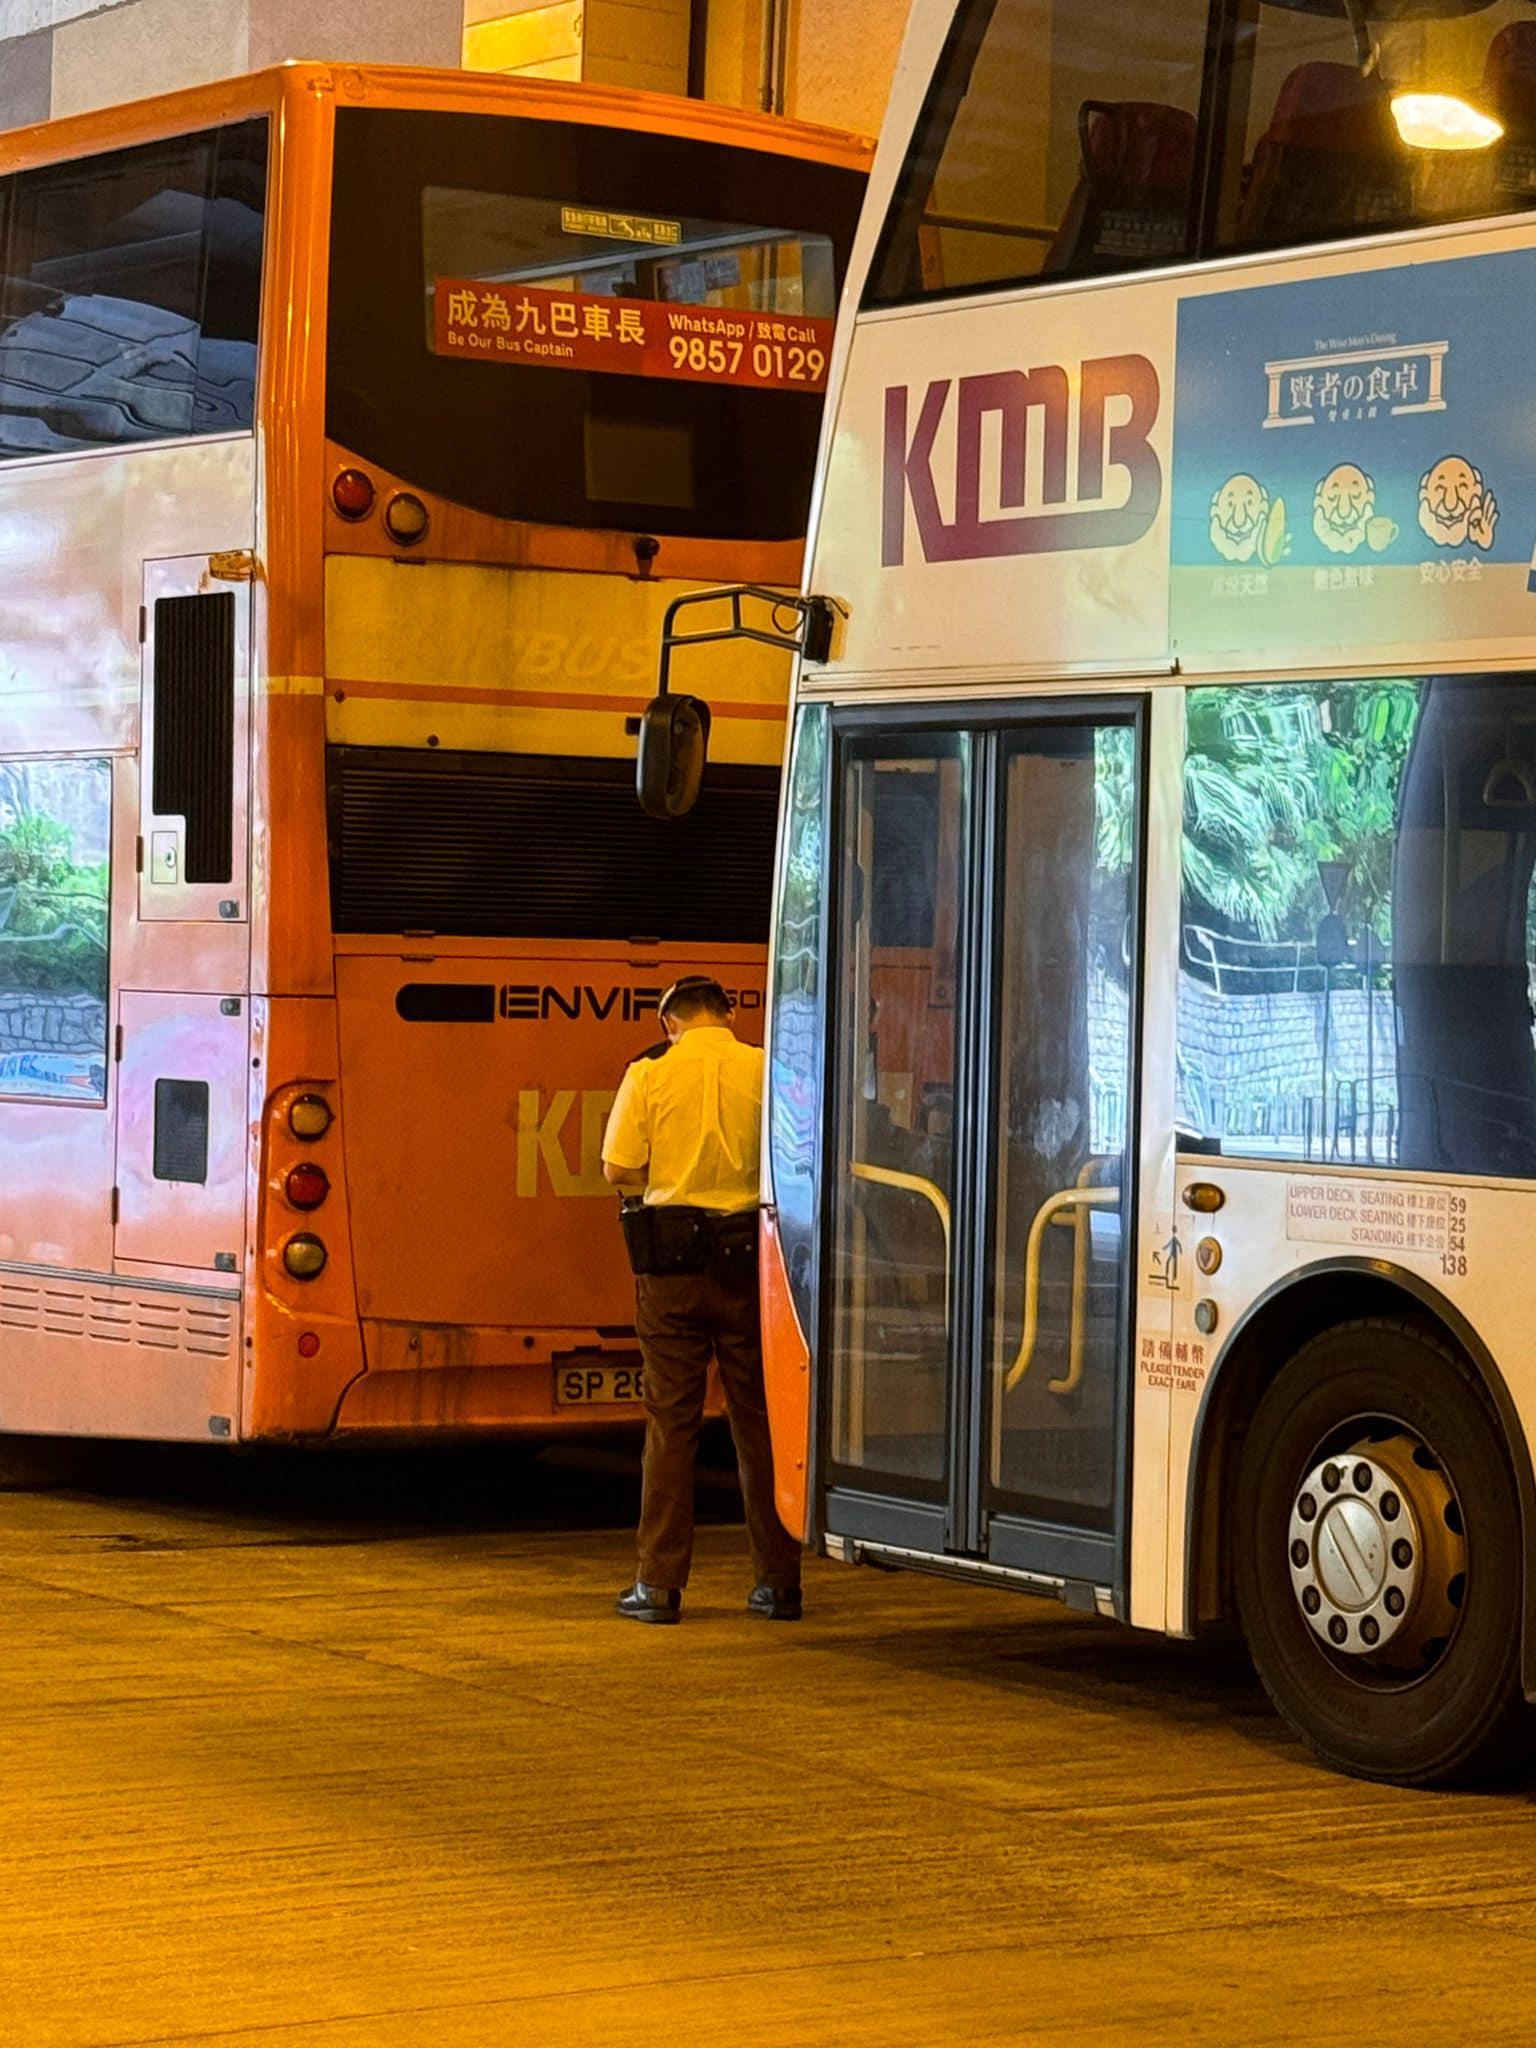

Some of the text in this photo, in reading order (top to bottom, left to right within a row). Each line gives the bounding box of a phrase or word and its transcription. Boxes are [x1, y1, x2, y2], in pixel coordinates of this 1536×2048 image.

[448, 289, 645, 345] 成為九巴車長
[668, 313, 745, 339] WhatsApp
[448, 331, 574, 358] Be Our Bus Captain
[669, 335, 825, 382] 9857 0129
[1289, 362, 1418, 411] 賢者の食卓
[881, 354, 1162, 568] KMB
[1290, 1184, 1324, 1201] UPPER
[1326, 1189, 1355, 1204] DECK
[1360, 1190, 1404, 1209] SEATING
[1450, 1196, 1466, 1214] 59
[1290, 1204, 1327, 1220] LOWER
[1329, 1208, 1357, 1223] DECK
[1360, 1209, 1404, 1227] SEATING
[1451, 1217, 1466, 1234] 25
[1351, 1228, 1404, 1246] STANDING
[1449, 1235, 1465, 1252] 54
[1440, 1253, 1467, 1277] 138
[565, 1371, 603, 1399] SP
[1148, 1375, 1197, 1392] EXACT FARE
[1173, 1365, 1205, 1379] TENDER
